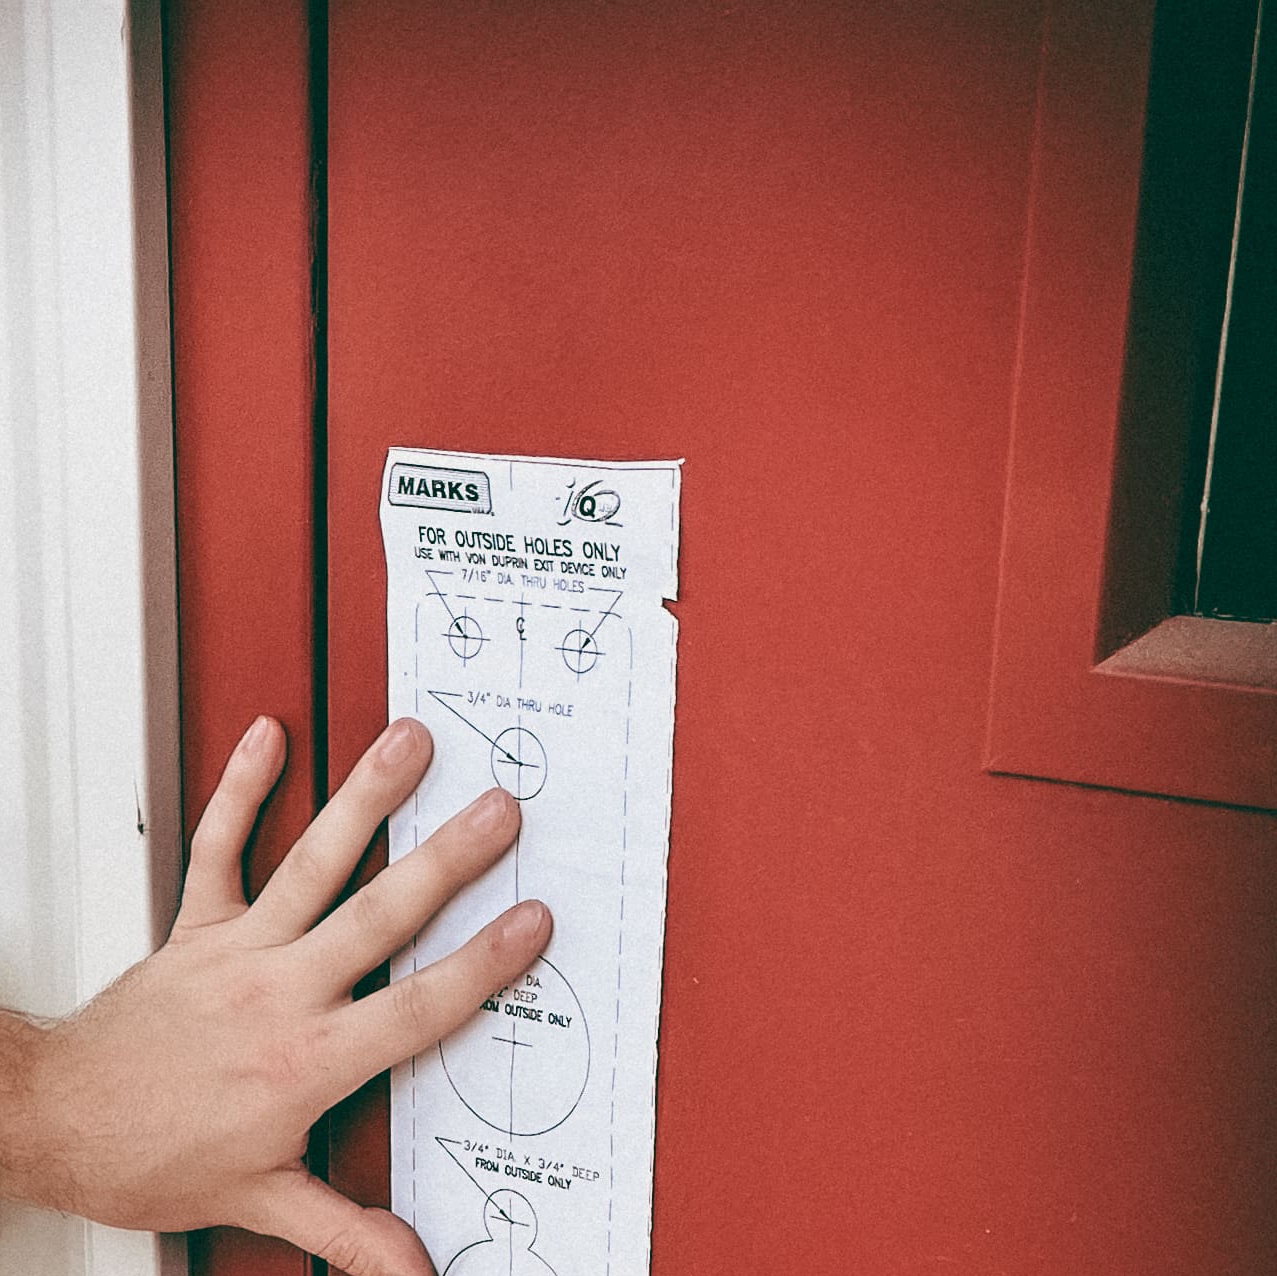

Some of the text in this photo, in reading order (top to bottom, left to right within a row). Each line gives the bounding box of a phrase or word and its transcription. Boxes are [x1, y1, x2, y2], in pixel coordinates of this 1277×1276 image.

[397, 475, 480, 502] MARKS
[418, 525, 621, 562] FOR OUTSIDE HOLES ONLY
[413, 546, 627, 580] USE WITH VON DUPRIN EXIT DEVICE ONLY
[521, 574, 547, 589] THRU
[553, 578, 585, 594] HOLES
[467, 691, 491, 707] 3/4"
[516, 697, 542, 713] THRU
[548, 703, 574, 717] HOLE
[513, 988, 538, 1004] DEEP
[504, 1003, 544, 1022] OUTSIDE
[547, 1012, 572, 1028] ONLY
[475, 1157, 572, 1190] FROM OUTSIDE ONLY
[571, 1166, 600, 1182] DEEP
